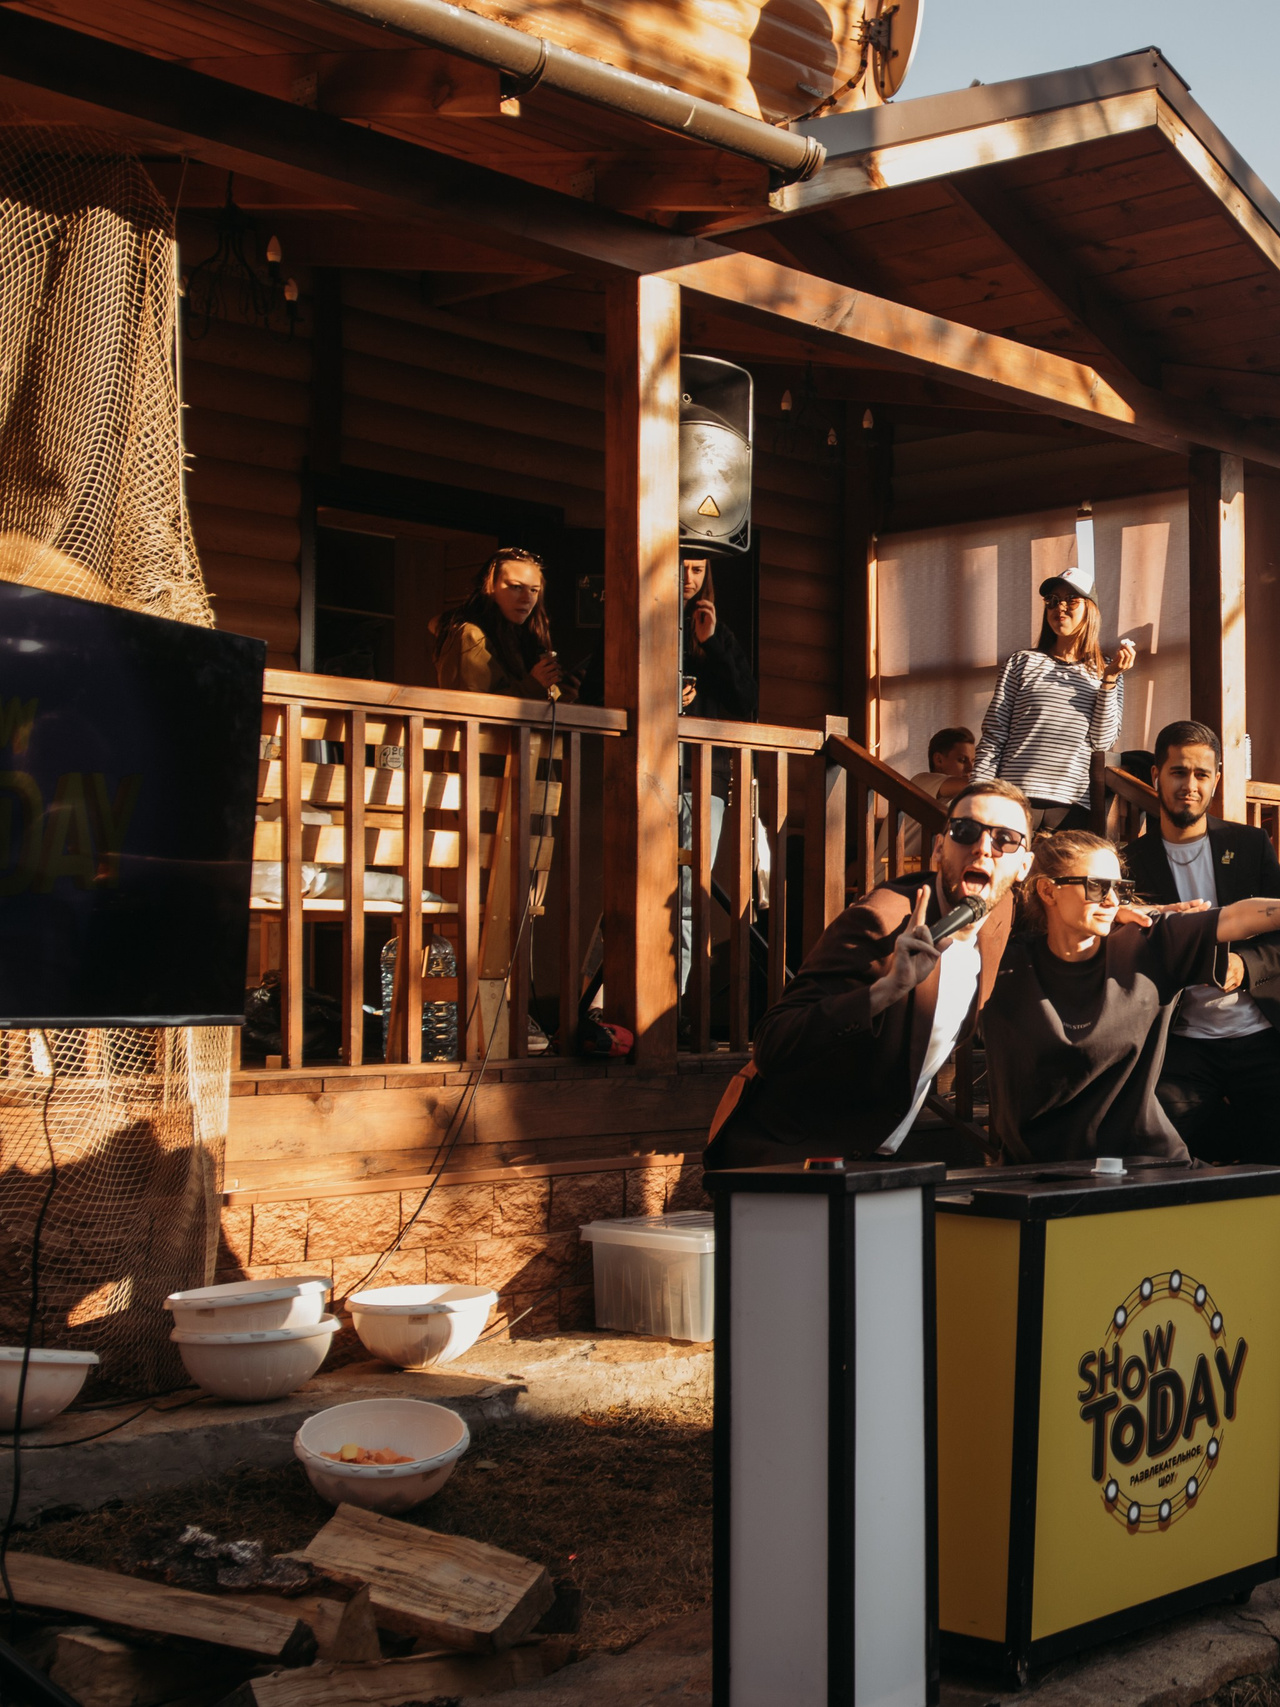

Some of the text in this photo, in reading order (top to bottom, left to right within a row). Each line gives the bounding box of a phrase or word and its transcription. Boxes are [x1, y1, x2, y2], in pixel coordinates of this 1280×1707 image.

[0, 771, 143, 893] DAY
[1078, 1320, 1174, 1402] SHOW
[1080, 1337, 1247, 1482] TODAY
[1129, 1444, 1202, 1486] РАЗВЛЕКАТЕЛЬНОЕ
[1158, 1472, 1175, 1488] ШОУ
